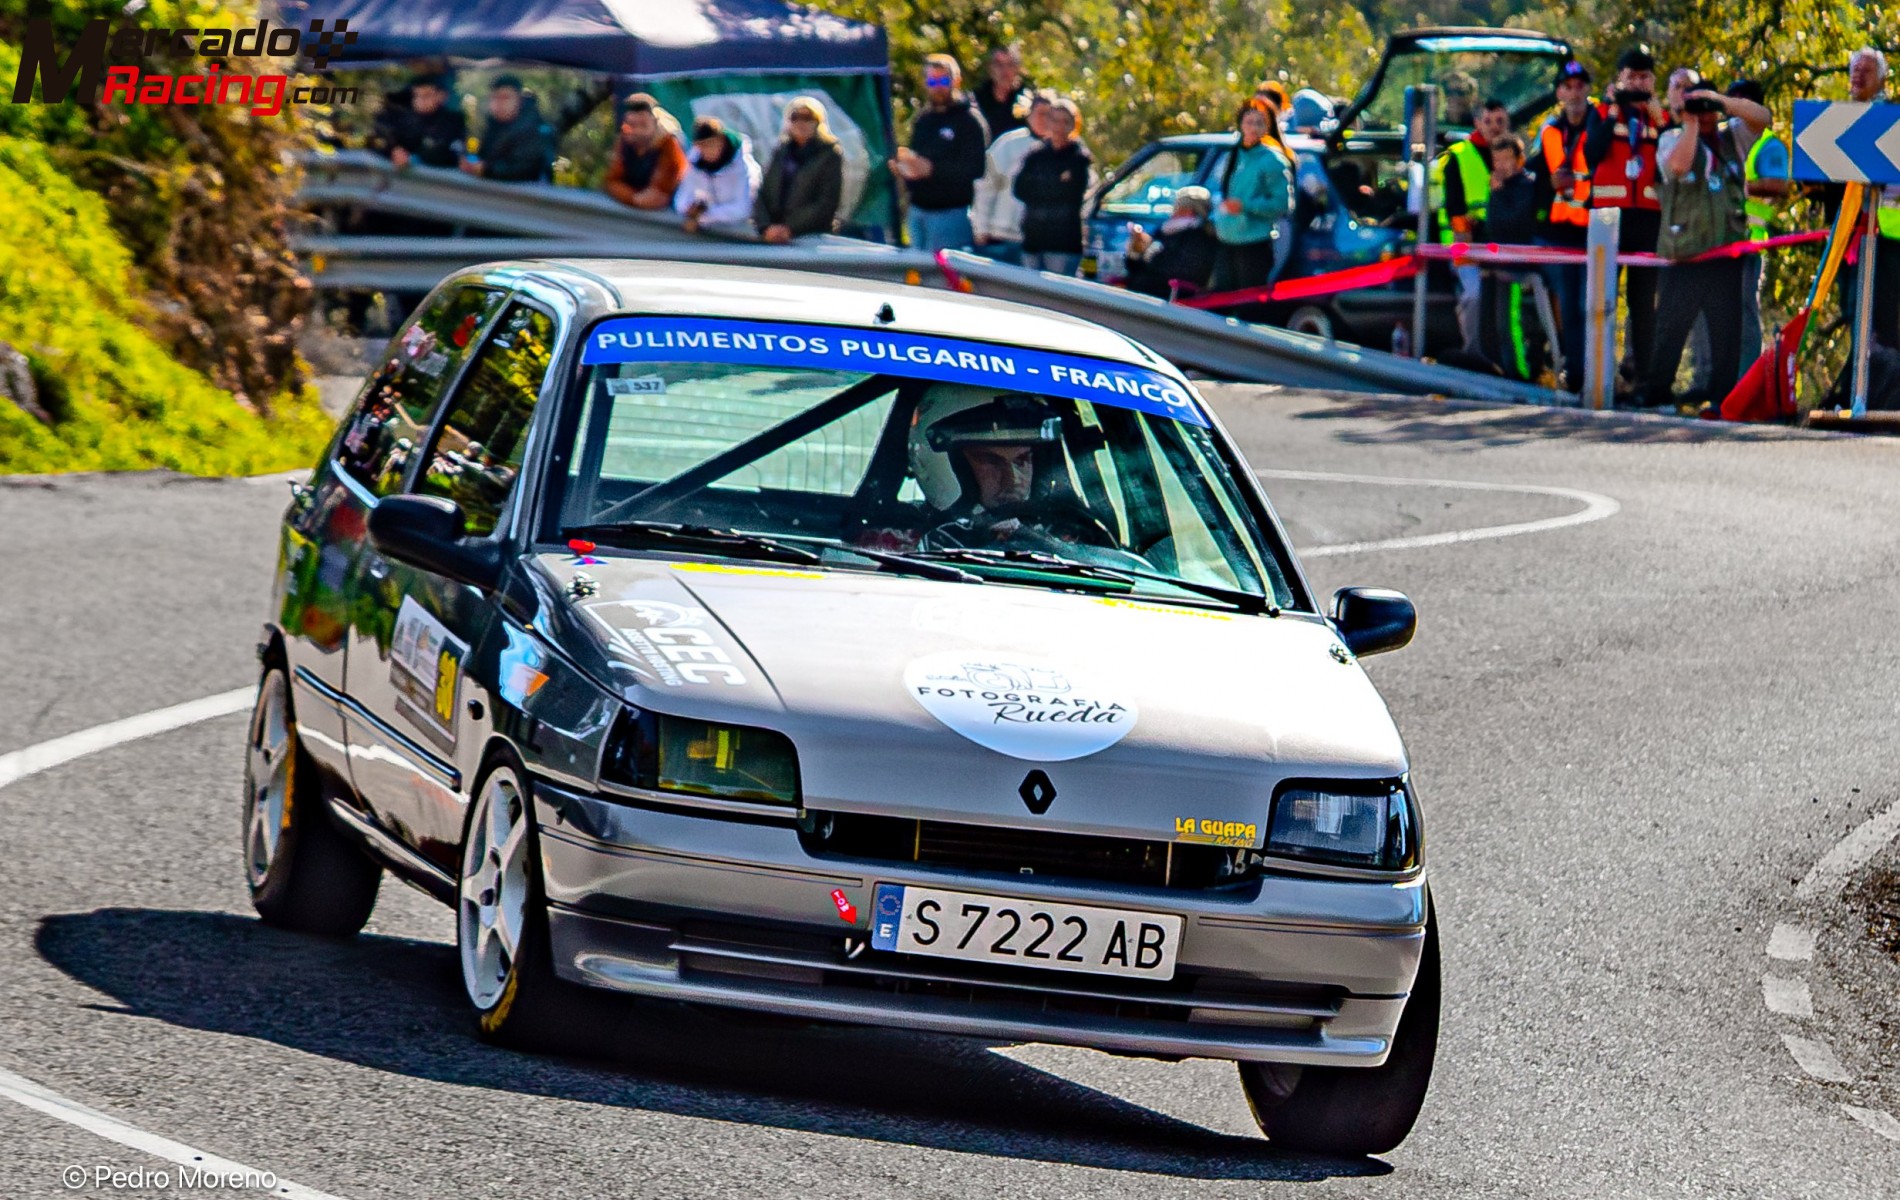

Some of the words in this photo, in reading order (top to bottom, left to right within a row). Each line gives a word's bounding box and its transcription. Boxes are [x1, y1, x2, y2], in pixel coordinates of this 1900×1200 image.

[597, 330, 829, 354] PULIMENTOS
[840, 338, 1016, 375] PULGARIN
[1050, 365, 1188, 407] FRANCO
[987, 701, 1124, 725] Rueda
[1175, 817, 1196, 834] LA
[1200, 819, 1256, 839] GUAPA
[833, 890, 850, 912] TOW
[879, 924, 893, 938] E
[912, 900, 942, 946] S
[956, 904, 1088, 962] 7222
[1101, 920, 1166, 969] AB
